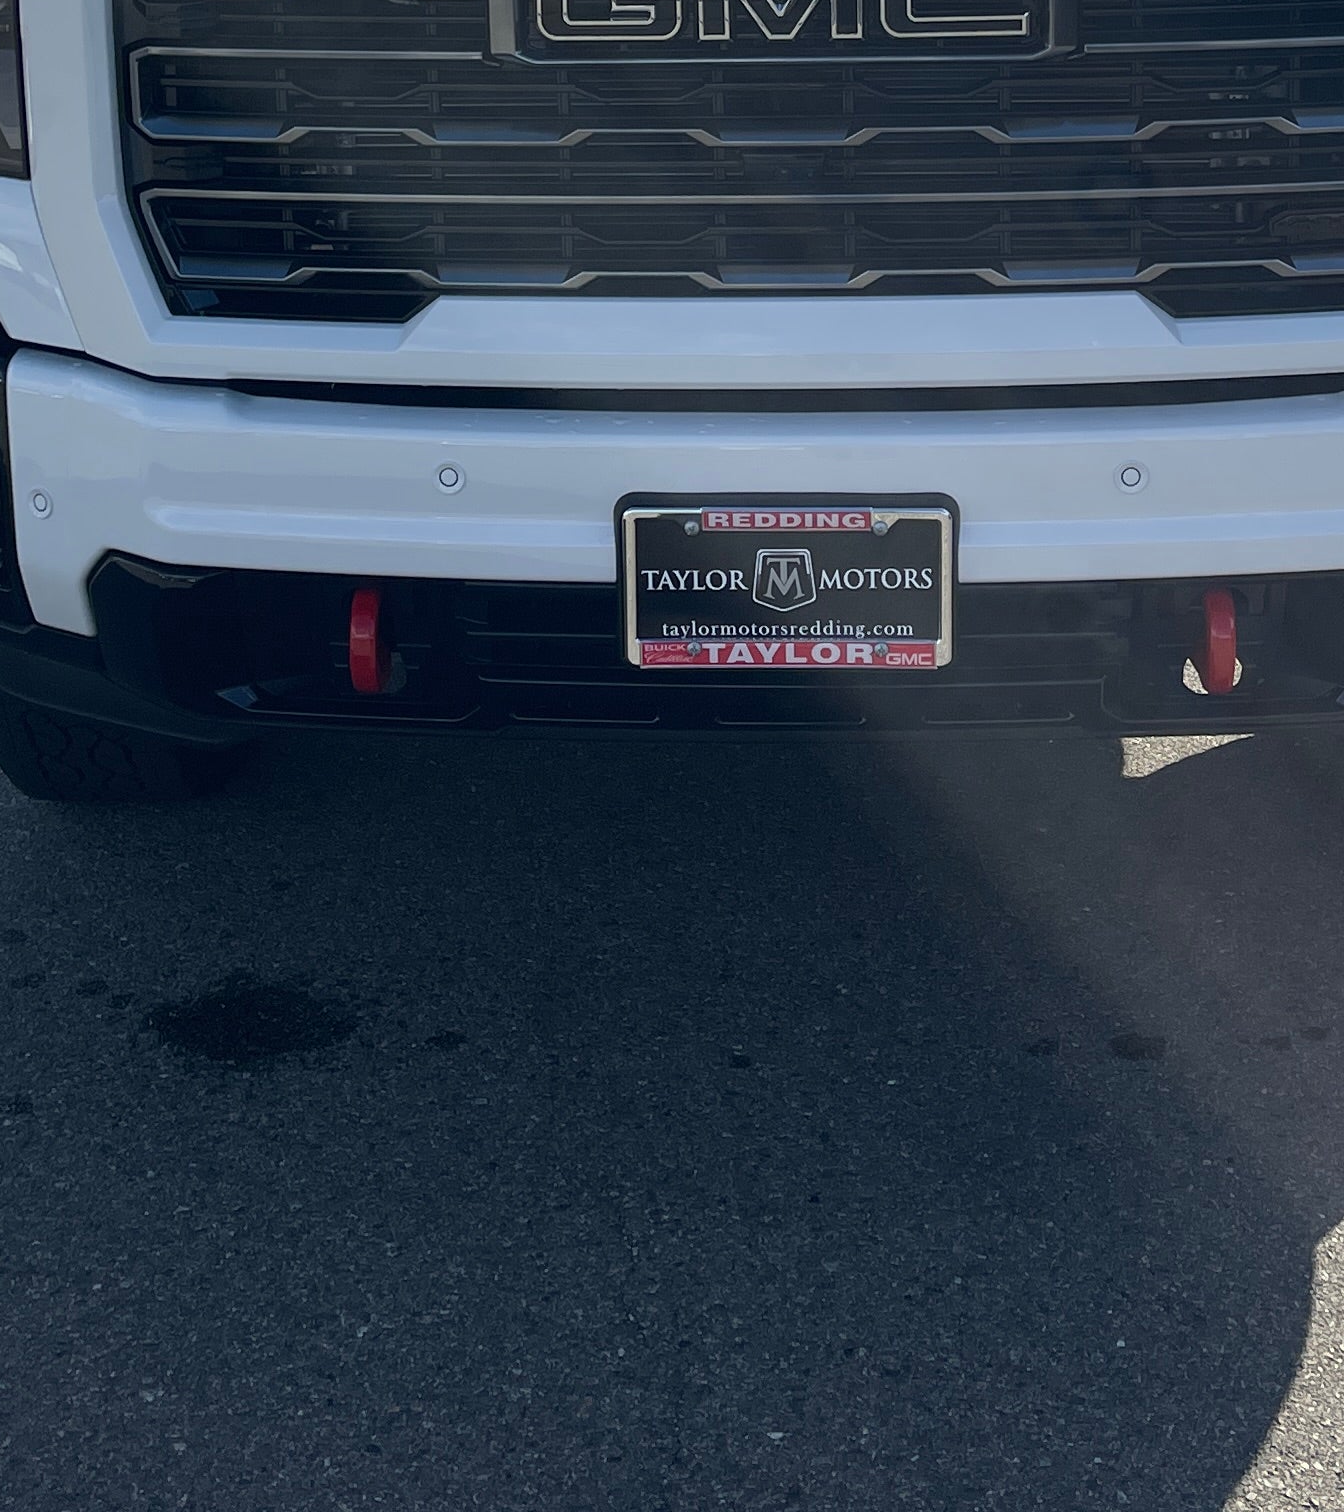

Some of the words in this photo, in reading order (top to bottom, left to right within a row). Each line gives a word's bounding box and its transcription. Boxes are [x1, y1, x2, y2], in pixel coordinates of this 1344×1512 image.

[707, 512, 866, 529] REDDING
[641, 569, 749, 591] TAYLOR
[818, 567, 934, 591] MOTORS
[662, 620, 914, 639] taylormotorsredding.com
[644, 643, 686, 652] BUICK
[702, 642, 873, 664] TAYLOR
[885, 652, 933, 665] GMC
